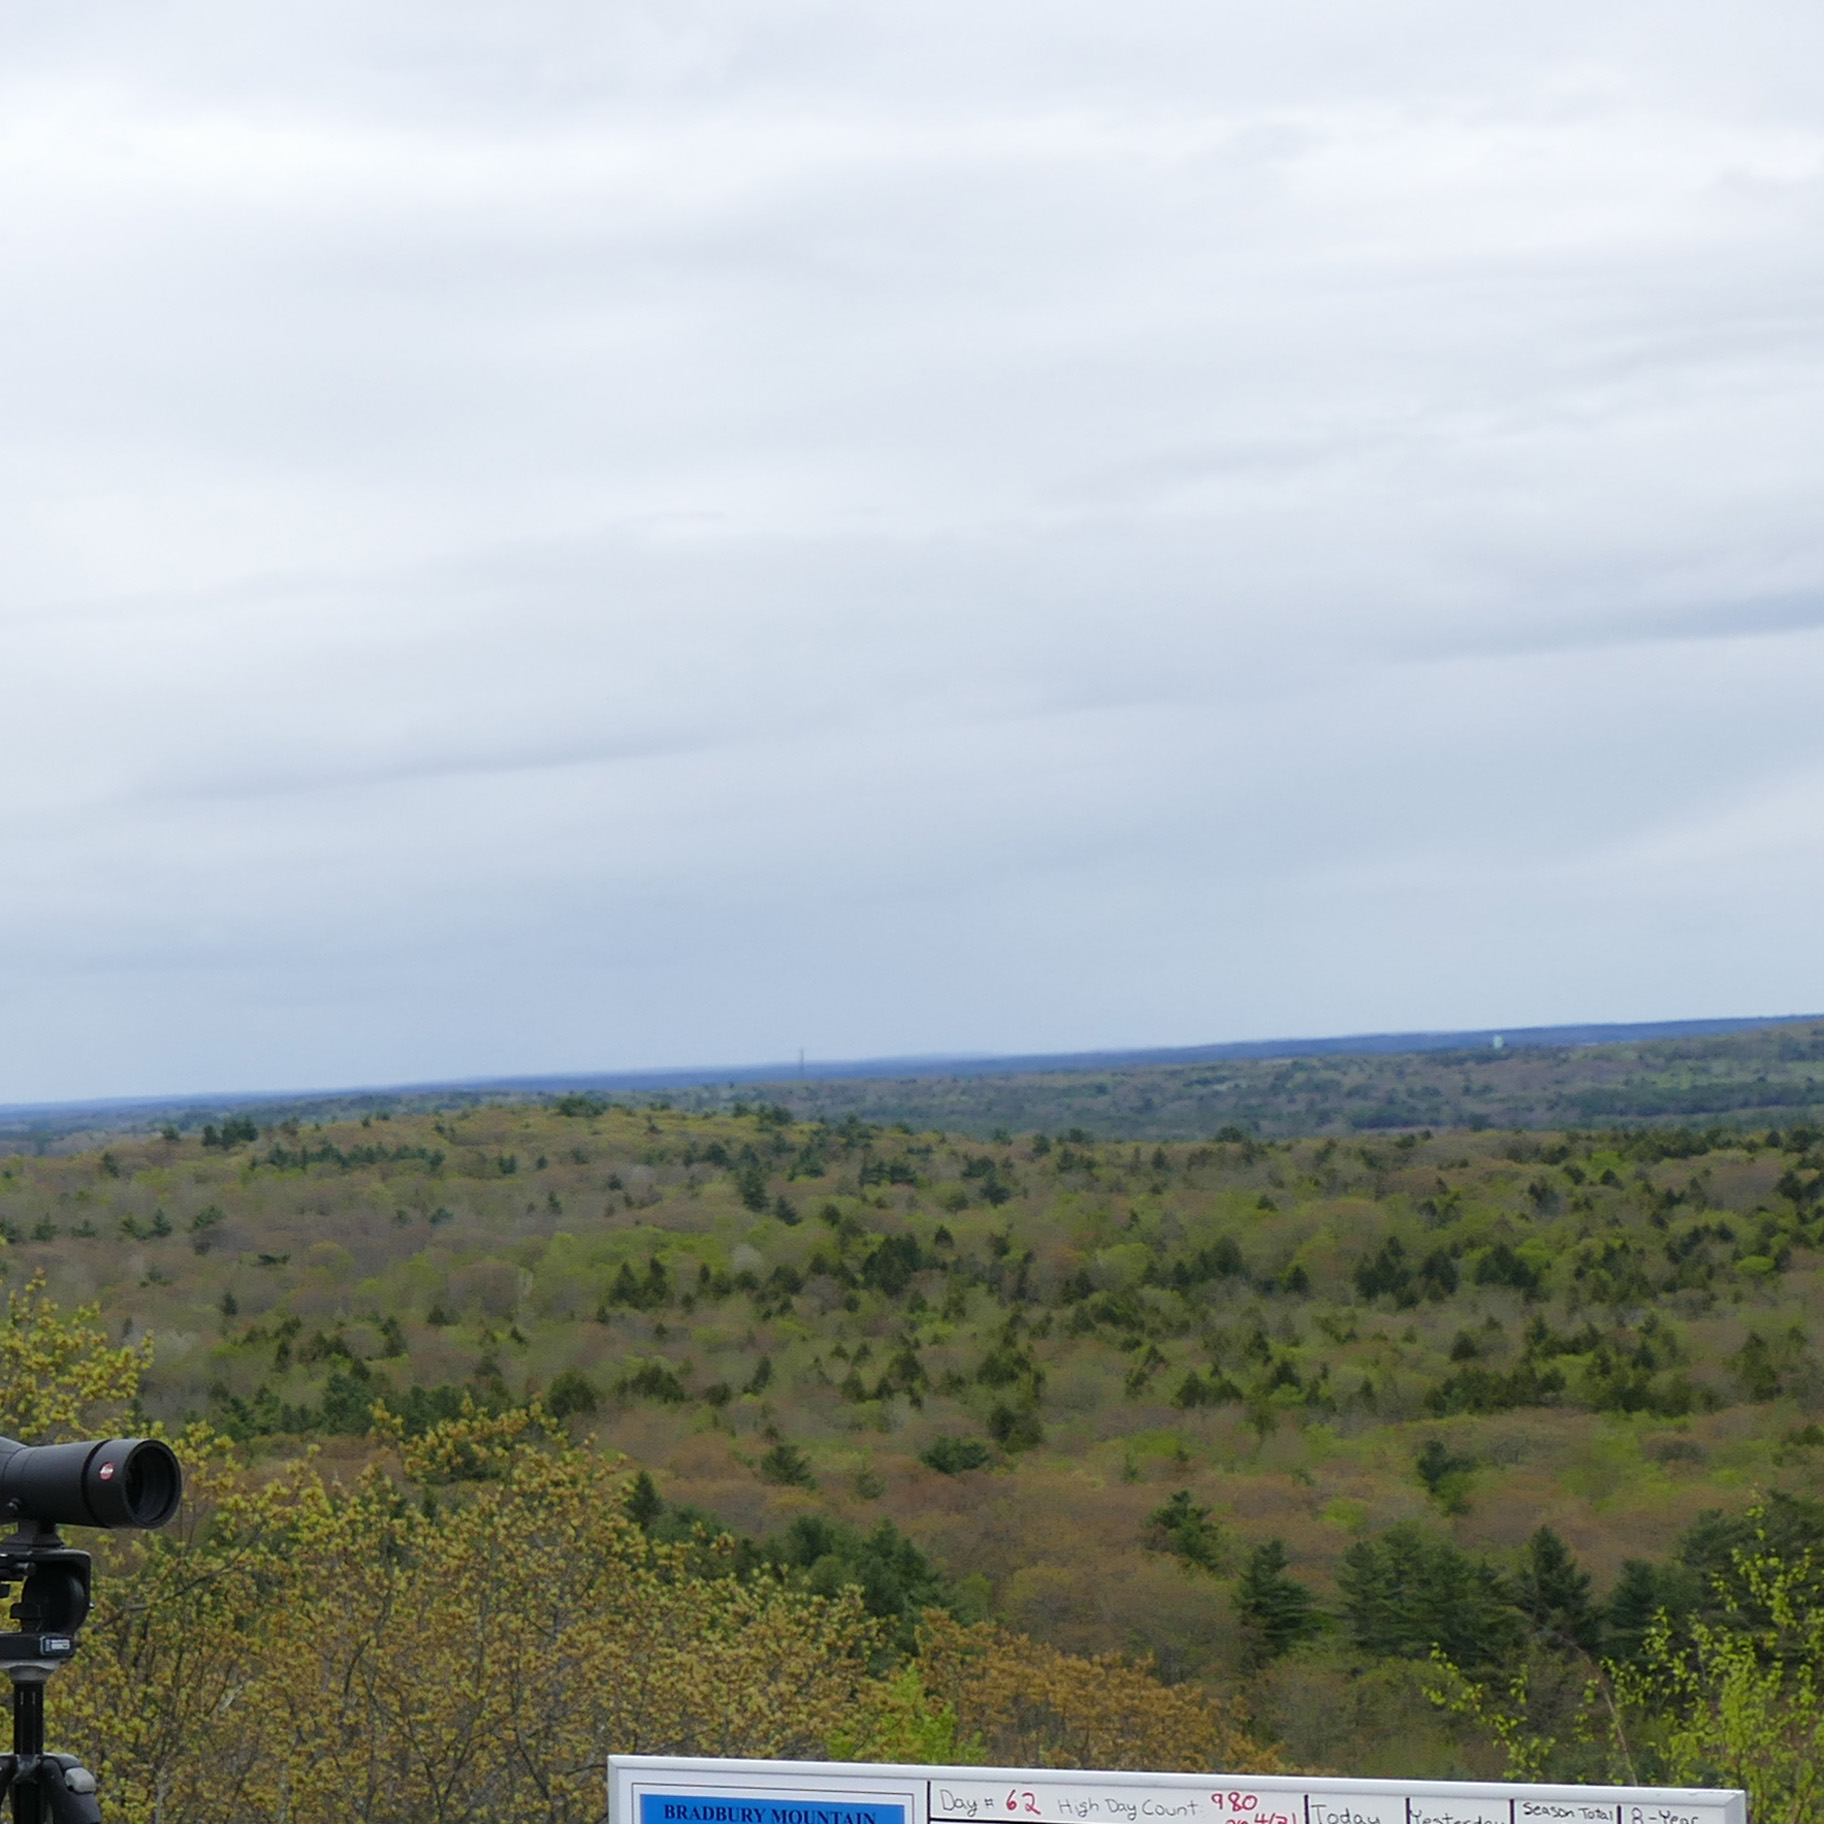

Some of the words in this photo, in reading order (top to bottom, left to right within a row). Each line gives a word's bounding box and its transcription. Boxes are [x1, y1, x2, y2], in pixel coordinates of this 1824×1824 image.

[664, 1804, 765, 1823] BRADBURY
[940, 1789, 977, 1818] Day
[1006, 1789, 1042, 1814] 62
[1059, 1792, 1100, 1819] High
[1106, 1798, 1138, 1821] Day
[1211, 1792, 1259, 1812] 980
[1522, 1800, 1576, 1818] Season
[1579, 1807, 1614, 1821] Total
